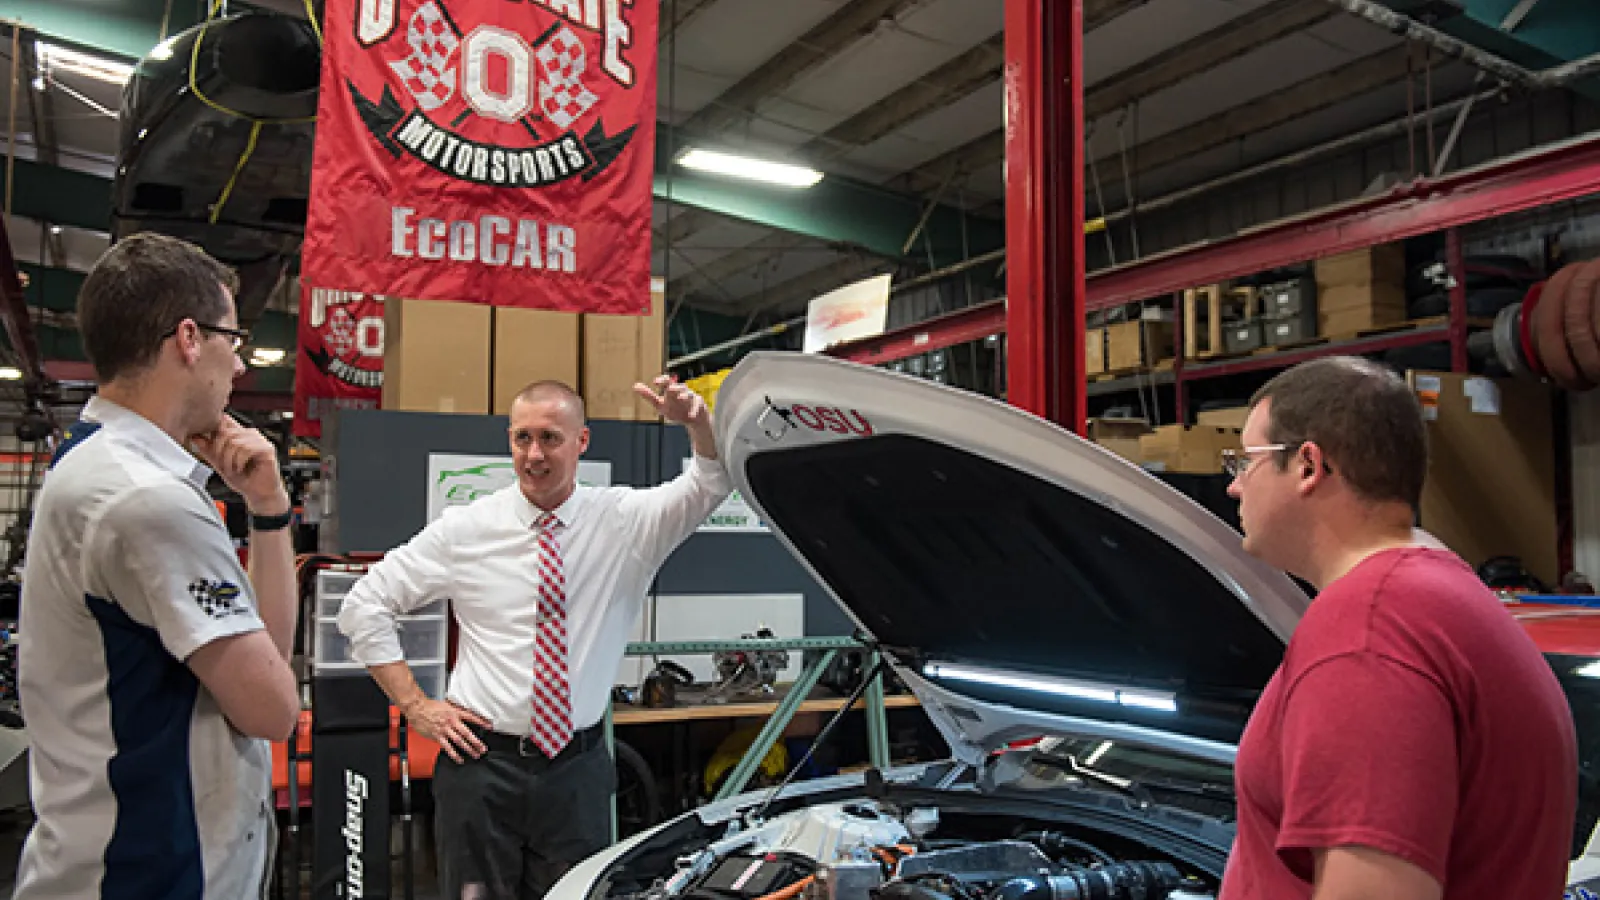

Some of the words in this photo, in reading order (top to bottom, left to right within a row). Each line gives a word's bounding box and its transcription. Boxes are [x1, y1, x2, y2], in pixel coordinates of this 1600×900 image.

[396, 114, 586, 184] MOTORSPORTS
[792, 404, 872, 437] OSU
[341, 769, 368, 900] Snap-on
